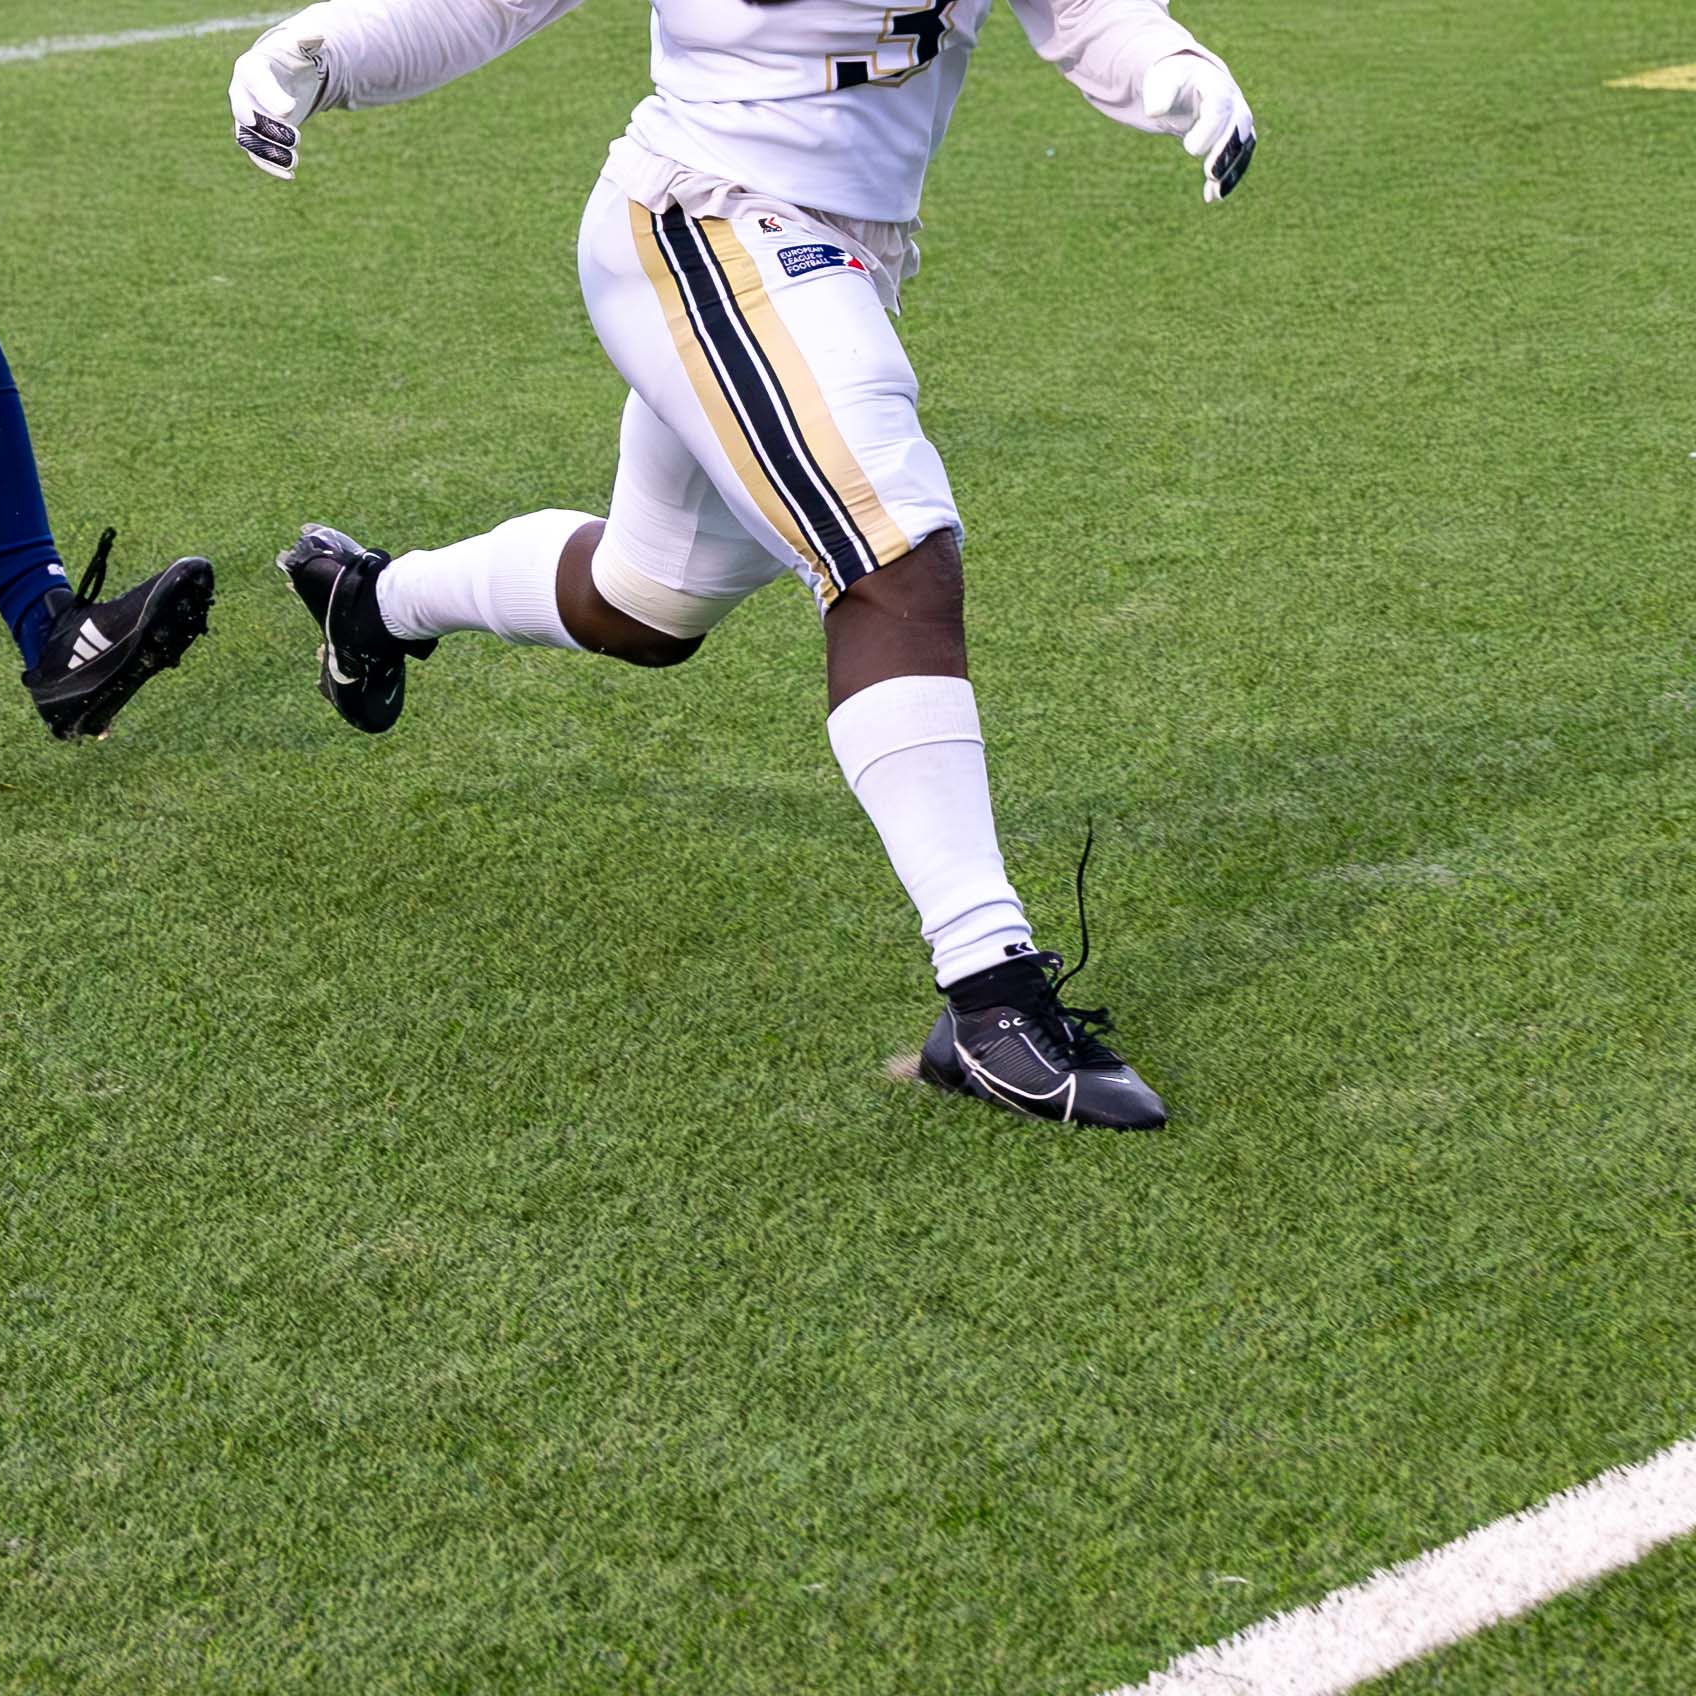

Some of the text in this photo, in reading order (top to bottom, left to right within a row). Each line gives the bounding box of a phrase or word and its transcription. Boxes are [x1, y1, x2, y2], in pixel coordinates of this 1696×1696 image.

[780, 246, 824, 259] EUROPEAN
[784, 253, 816, 266] LEAGUE
[787, 258, 830, 273] FOOTBALL
